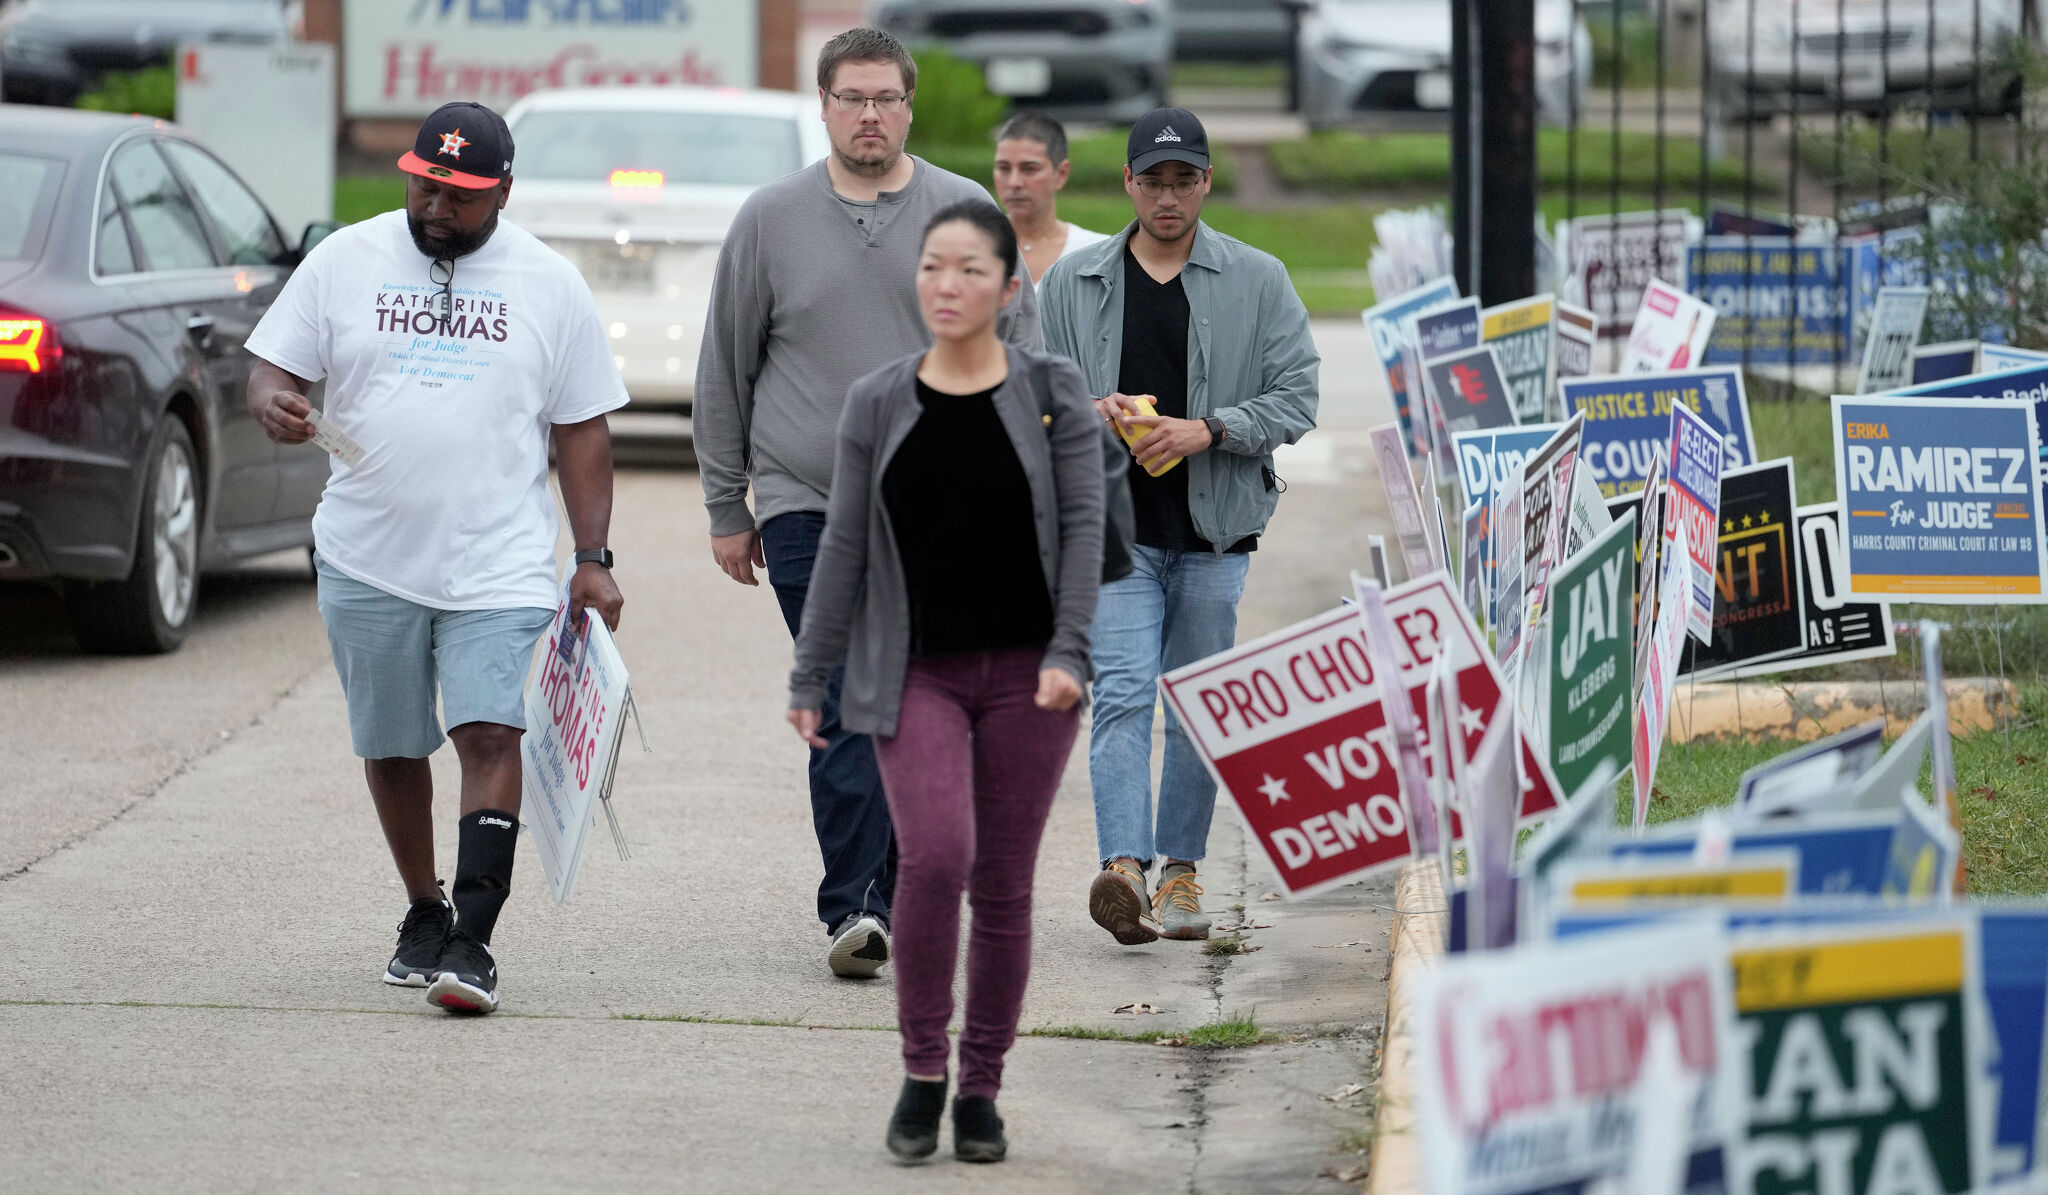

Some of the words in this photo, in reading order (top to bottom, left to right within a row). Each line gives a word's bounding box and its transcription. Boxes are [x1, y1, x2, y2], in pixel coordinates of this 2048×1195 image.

[1155, 134, 1182, 144] adidas
[376, 292, 507, 317] KATHERINE
[382, 282, 419, 292] Knowledge
[484, 290, 502, 299] Trust
[376, 308, 508, 343] THOMAS
[409, 337, 431, 351] for
[432, 339, 468, 355] Judge
[410, 353, 441, 365] Criminal
[442, 355, 468, 366] District
[469, 357, 490, 368] Court
[399, 364, 420, 376] Vote
[422, 368, 475, 382] Democrat
[1574, 391, 1648, 421] JUSTICE
[1846, 422, 1890, 439] ERIKA
[1680, 417, 1719, 477] RE-ELECT
[1848, 445, 2028, 494] RAMIREZ
[1666, 484, 1715, 568] DUNSON
[1889, 500, 1915, 528] For
[1919, 501, 1994, 530] JUDGE
[1852, 534, 1883, 550] HARRIS
[1884, 535, 1917, 551] COUNTY
[1918, 535, 1958, 552] CRIMINAL
[1959, 536, 1987, 552] COURT
[1988, 536, 1999, 552] AT
[2001, 537, 2018, 552] LAW
[2020, 537, 2033, 552] #8
[1560, 547, 1625, 681] JAY
[1713, 600, 1781, 629] CONGRESS
[1198, 667, 1292, 738] PRO
[1288, 606, 1444, 703] CHOE?
[1567, 654, 1616, 715] KLEBERG
[540, 634, 595, 792] THOMAS
[1576, 692, 1624, 759] COMMISSIONER
